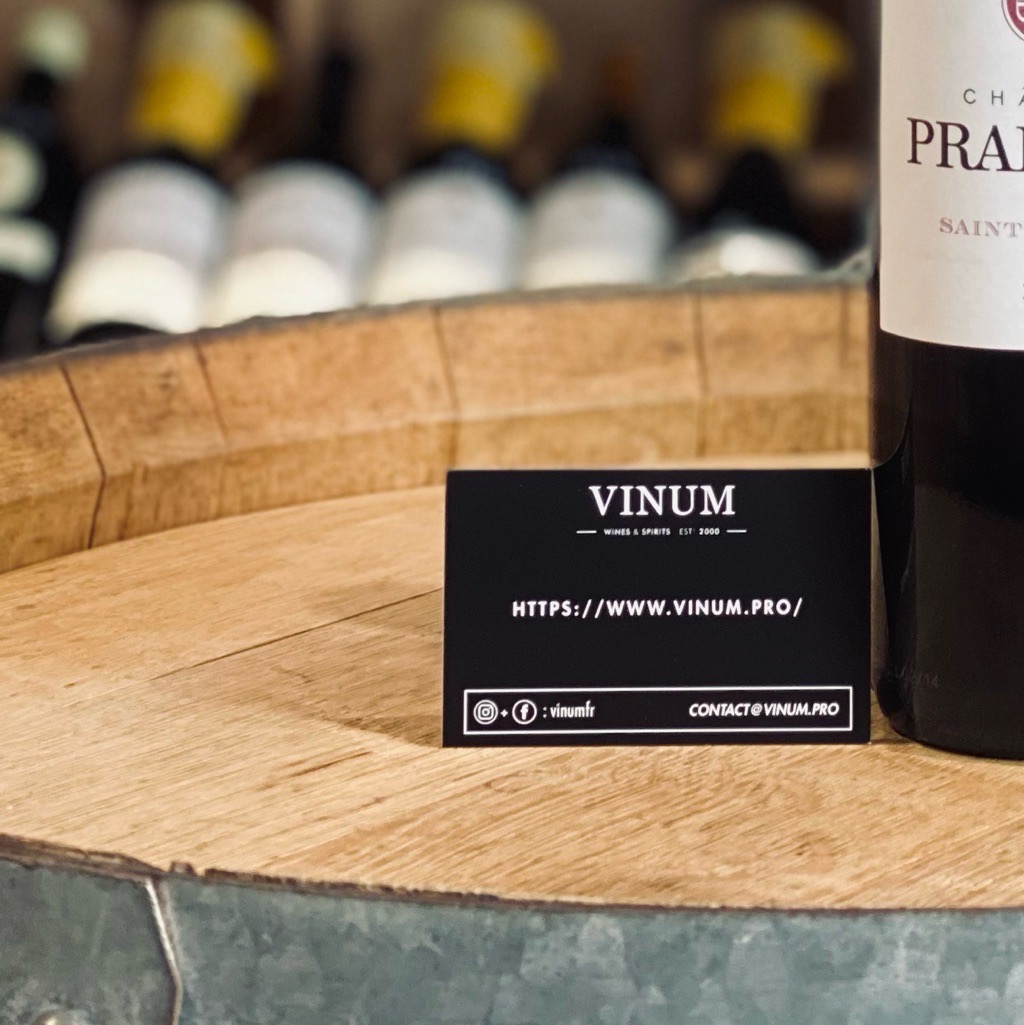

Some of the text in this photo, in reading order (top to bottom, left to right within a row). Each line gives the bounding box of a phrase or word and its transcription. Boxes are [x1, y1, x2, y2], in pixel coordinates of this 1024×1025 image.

[588, 484, 737, 517] VINUM
[603, 527, 631, 537] WINES
[641, 527, 672, 536] SPIRITS
[698, 527, 721, 536] 2000
[511, 597, 803, 619] HTTPS://WWW.VINUM.PRO/
[688, 701, 840, 718] CONTACT@VINUM.PRO
